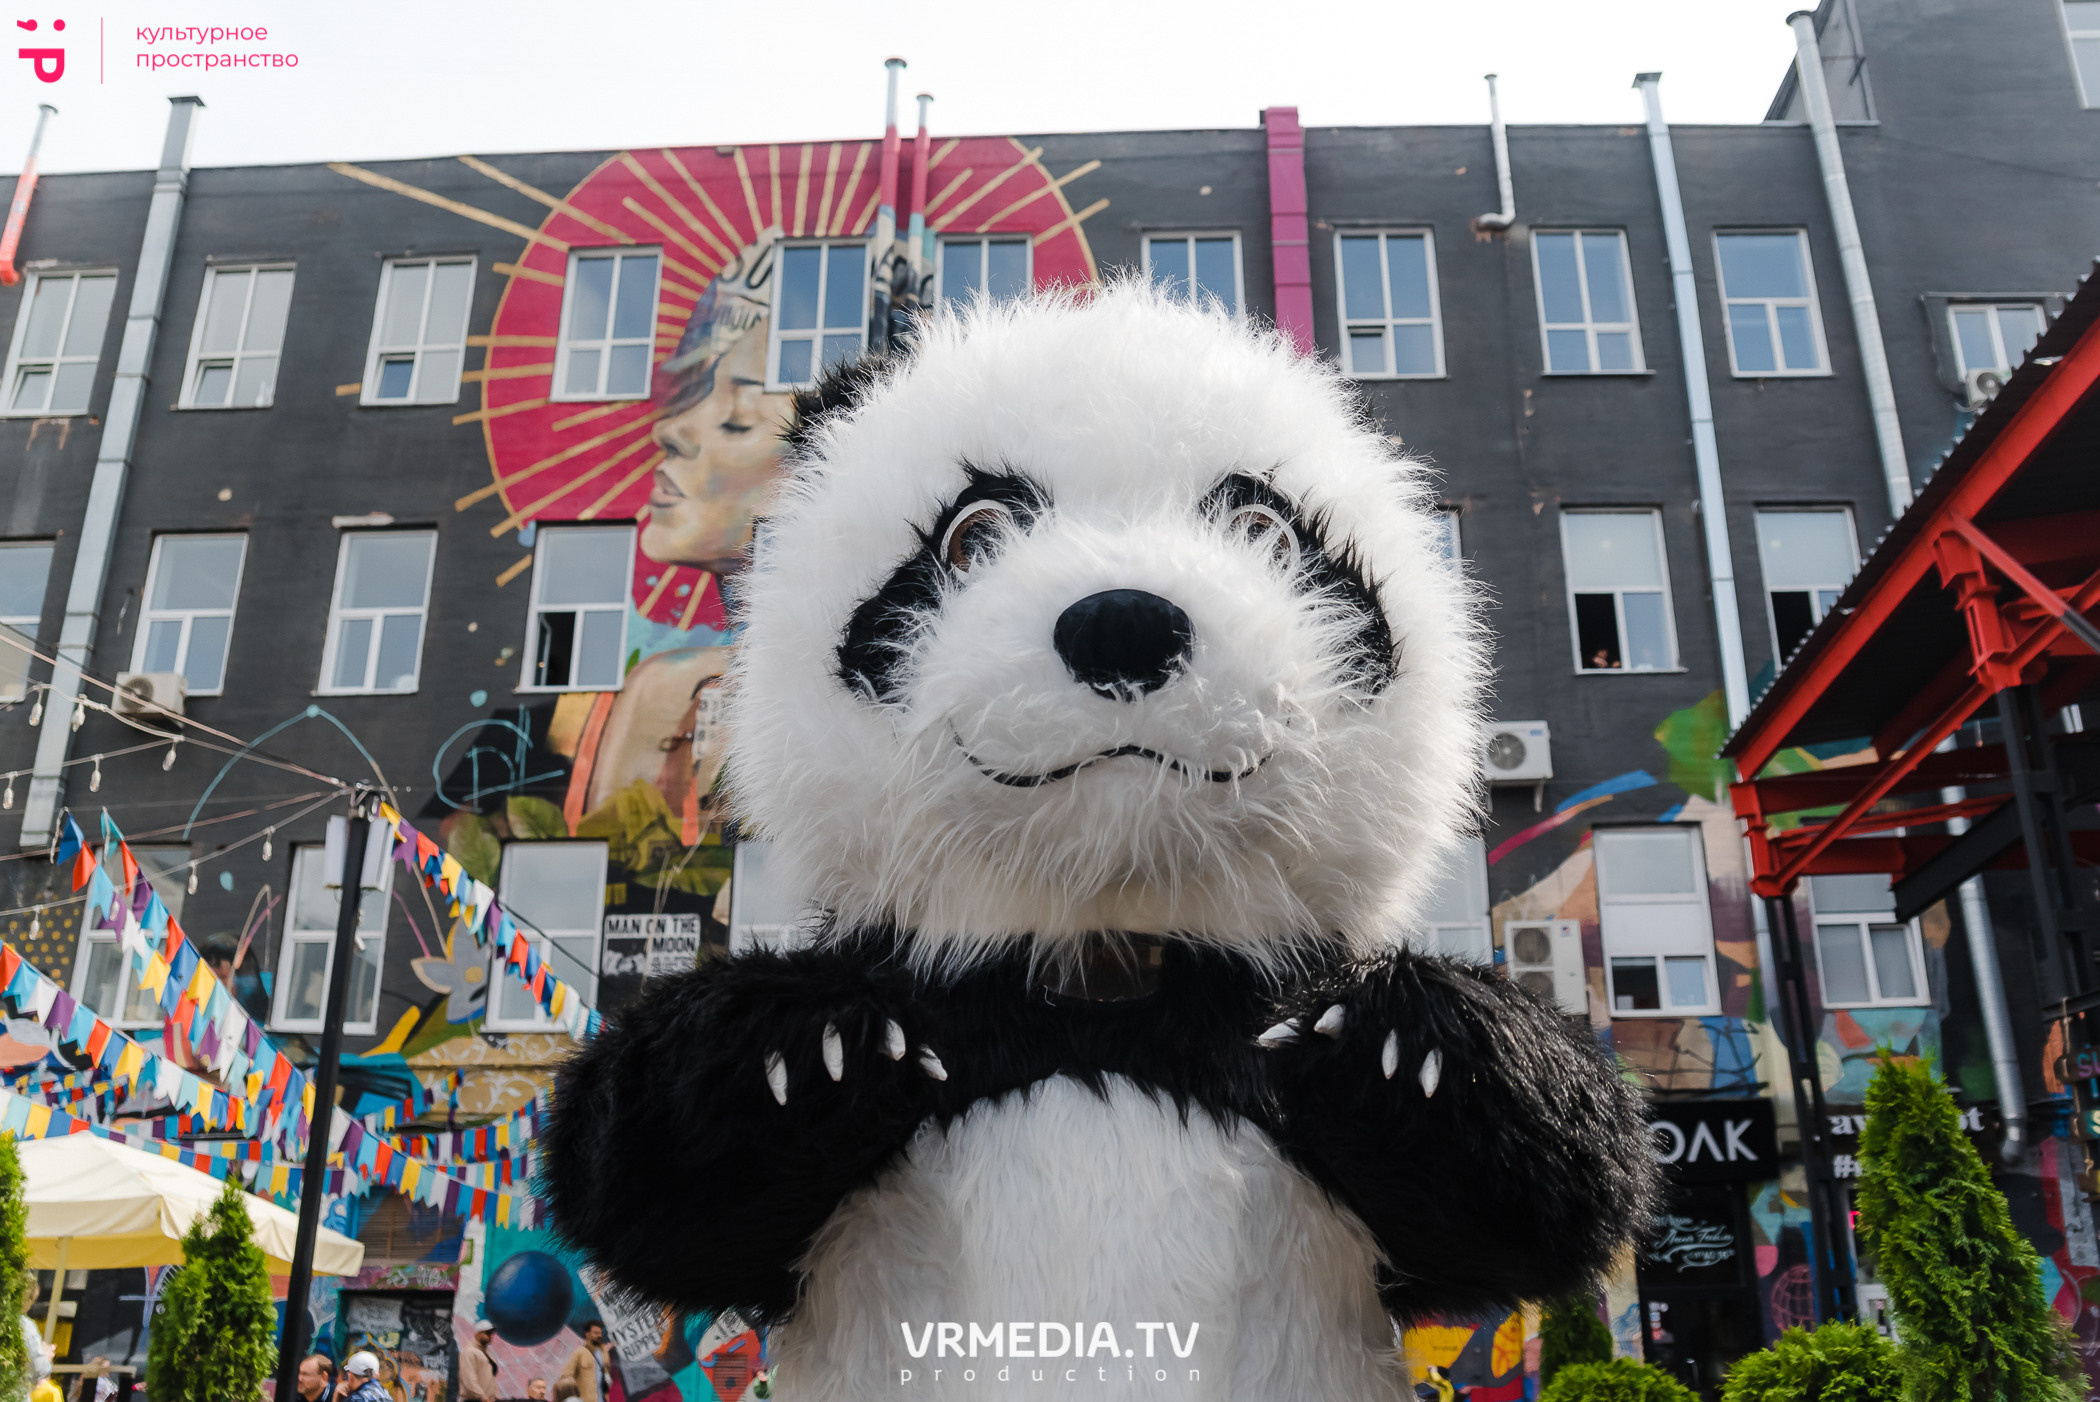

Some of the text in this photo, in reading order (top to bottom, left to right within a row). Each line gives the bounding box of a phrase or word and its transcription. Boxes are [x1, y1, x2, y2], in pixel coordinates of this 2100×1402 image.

[608, 917, 697, 933] MAN ON THE
[652, 937, 696, 952] MOON
